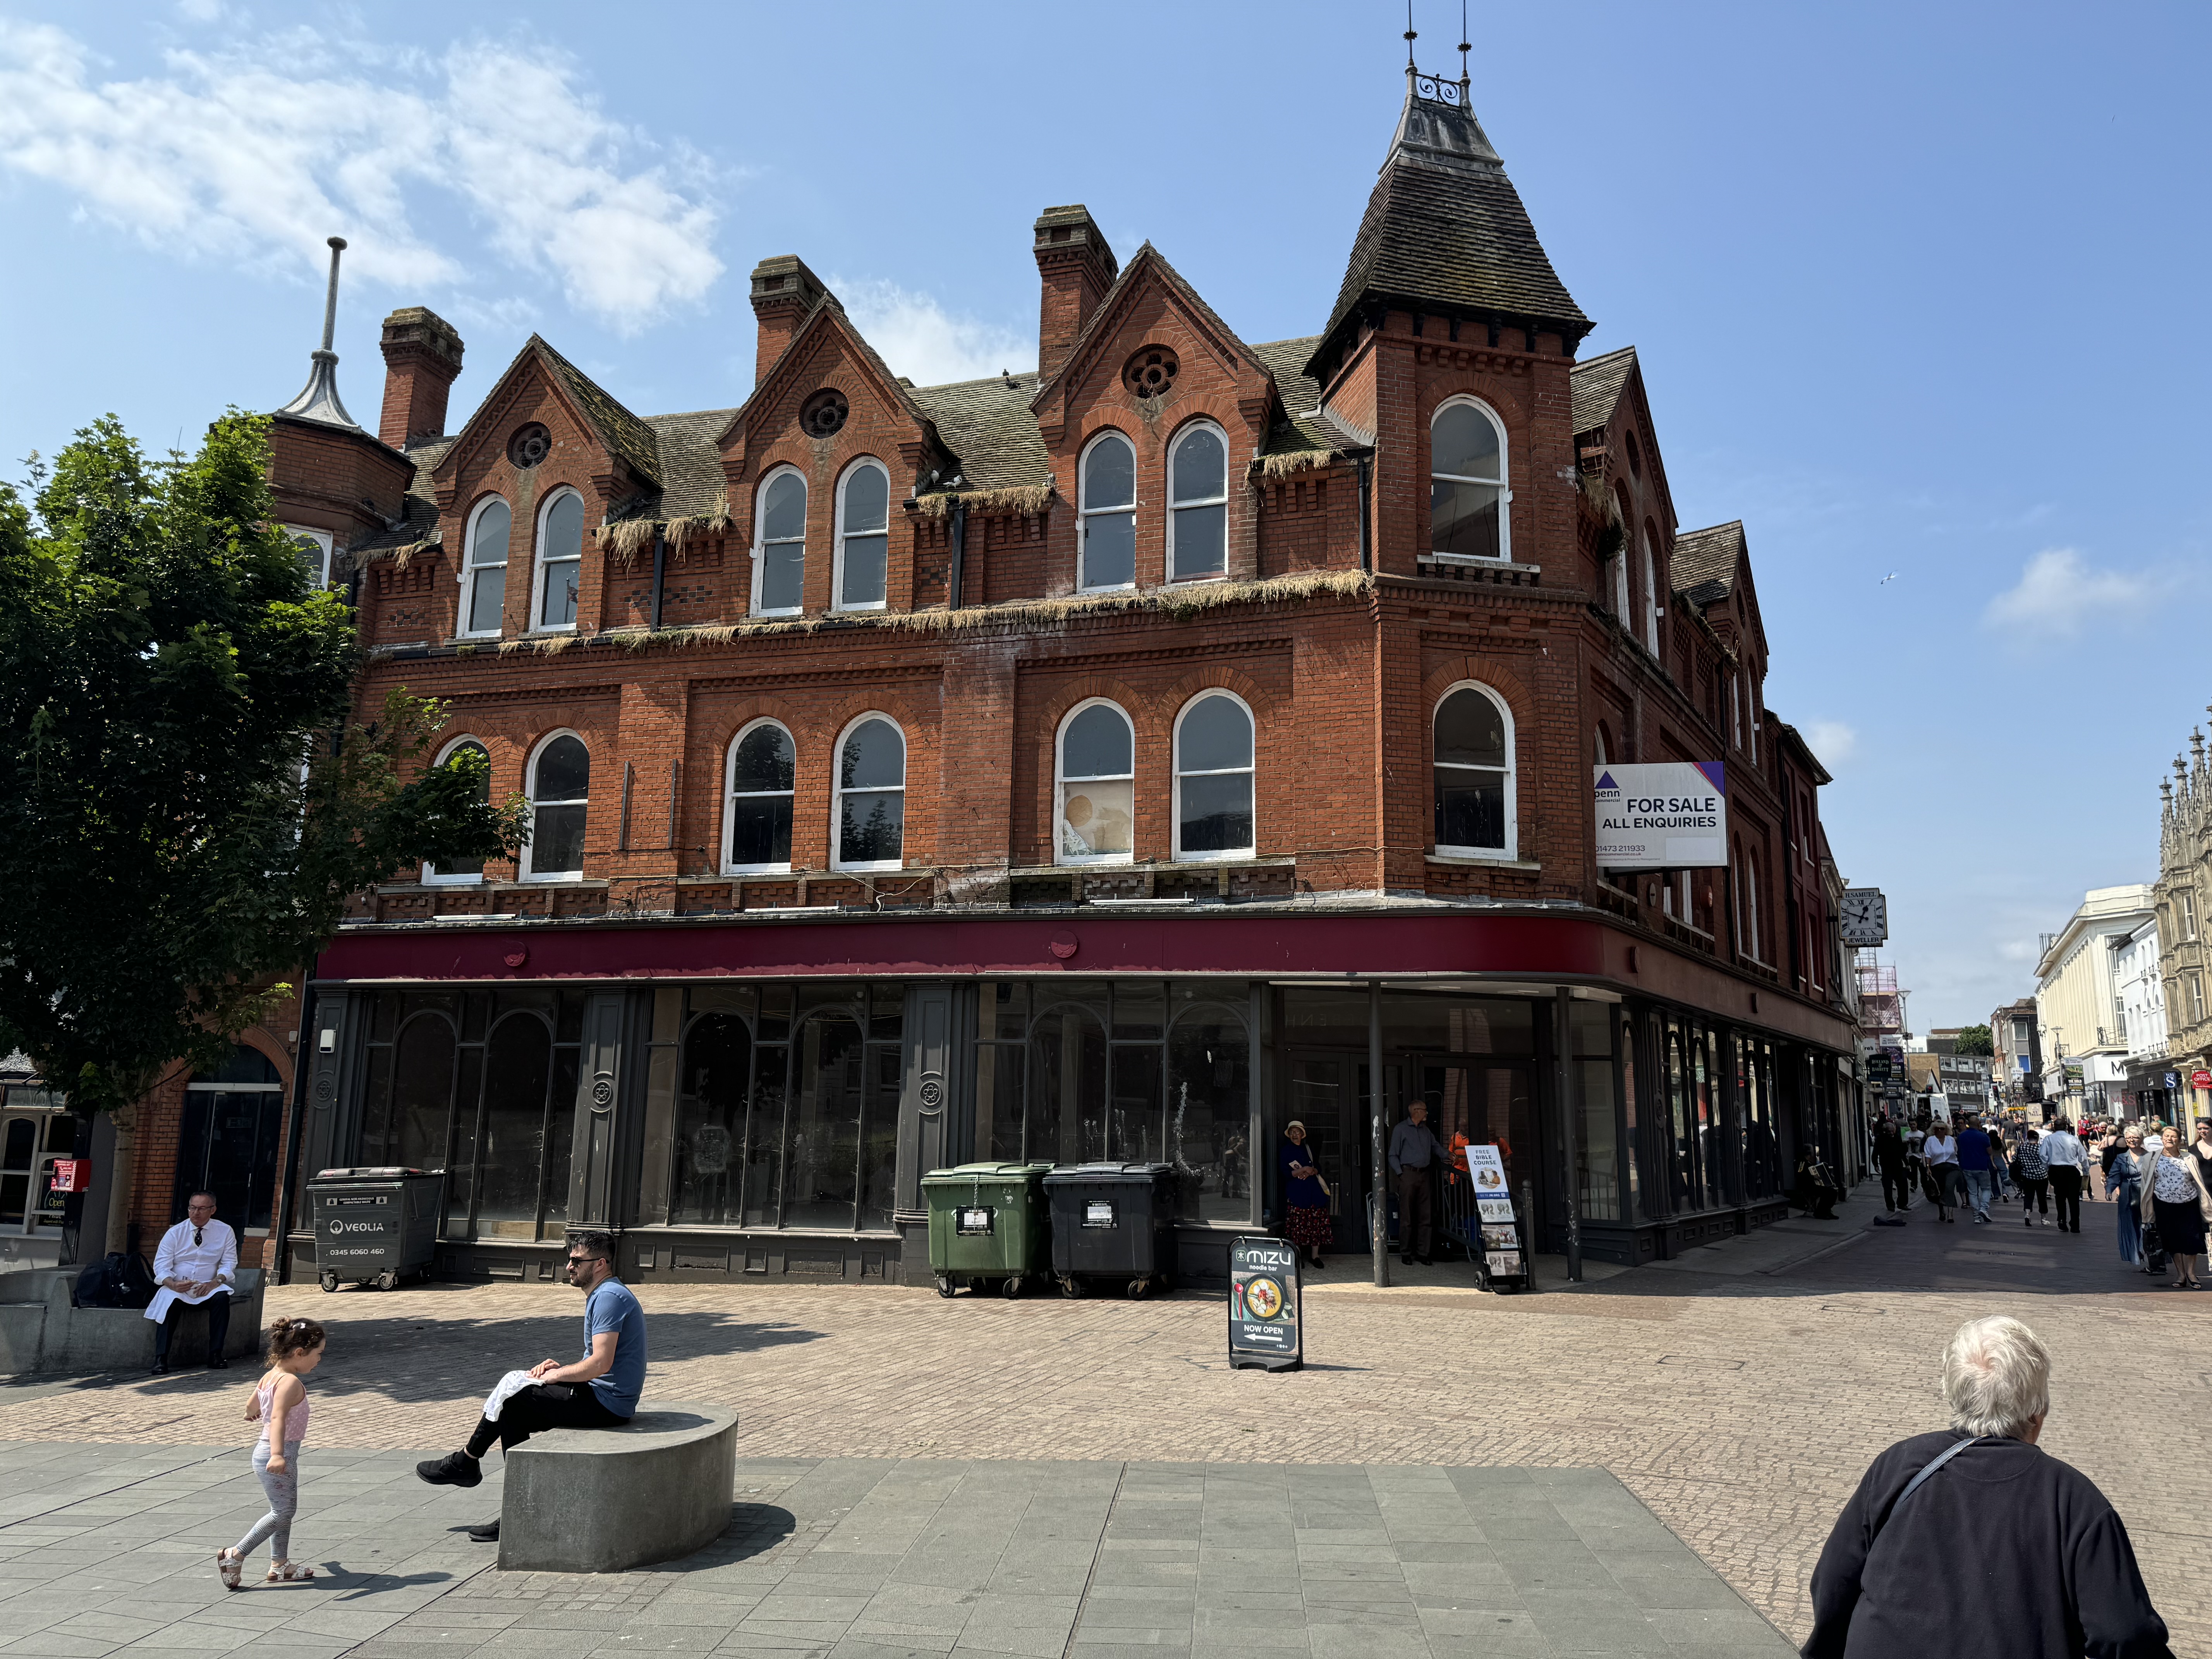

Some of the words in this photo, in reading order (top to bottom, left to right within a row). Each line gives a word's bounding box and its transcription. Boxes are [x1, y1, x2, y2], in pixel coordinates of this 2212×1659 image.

[1595, 790, 1620, 799] penn
[1627, 798, 1664, 812] FOR
[1669, 798, 1716, 812] SALE
[1602, 818, 1630, 829] ALL
[1634, 817, 1716, 828] ENQUIRIES
[2111, 1096, 2135, 1104] M&S
[49, 1198, 64, 1208] Open
[345, 1223, 384, 1231] VEOLIA
[1244, 1324, 1262, 1333] NOW
[1263, 1326, 1283, 1334] OPEN
